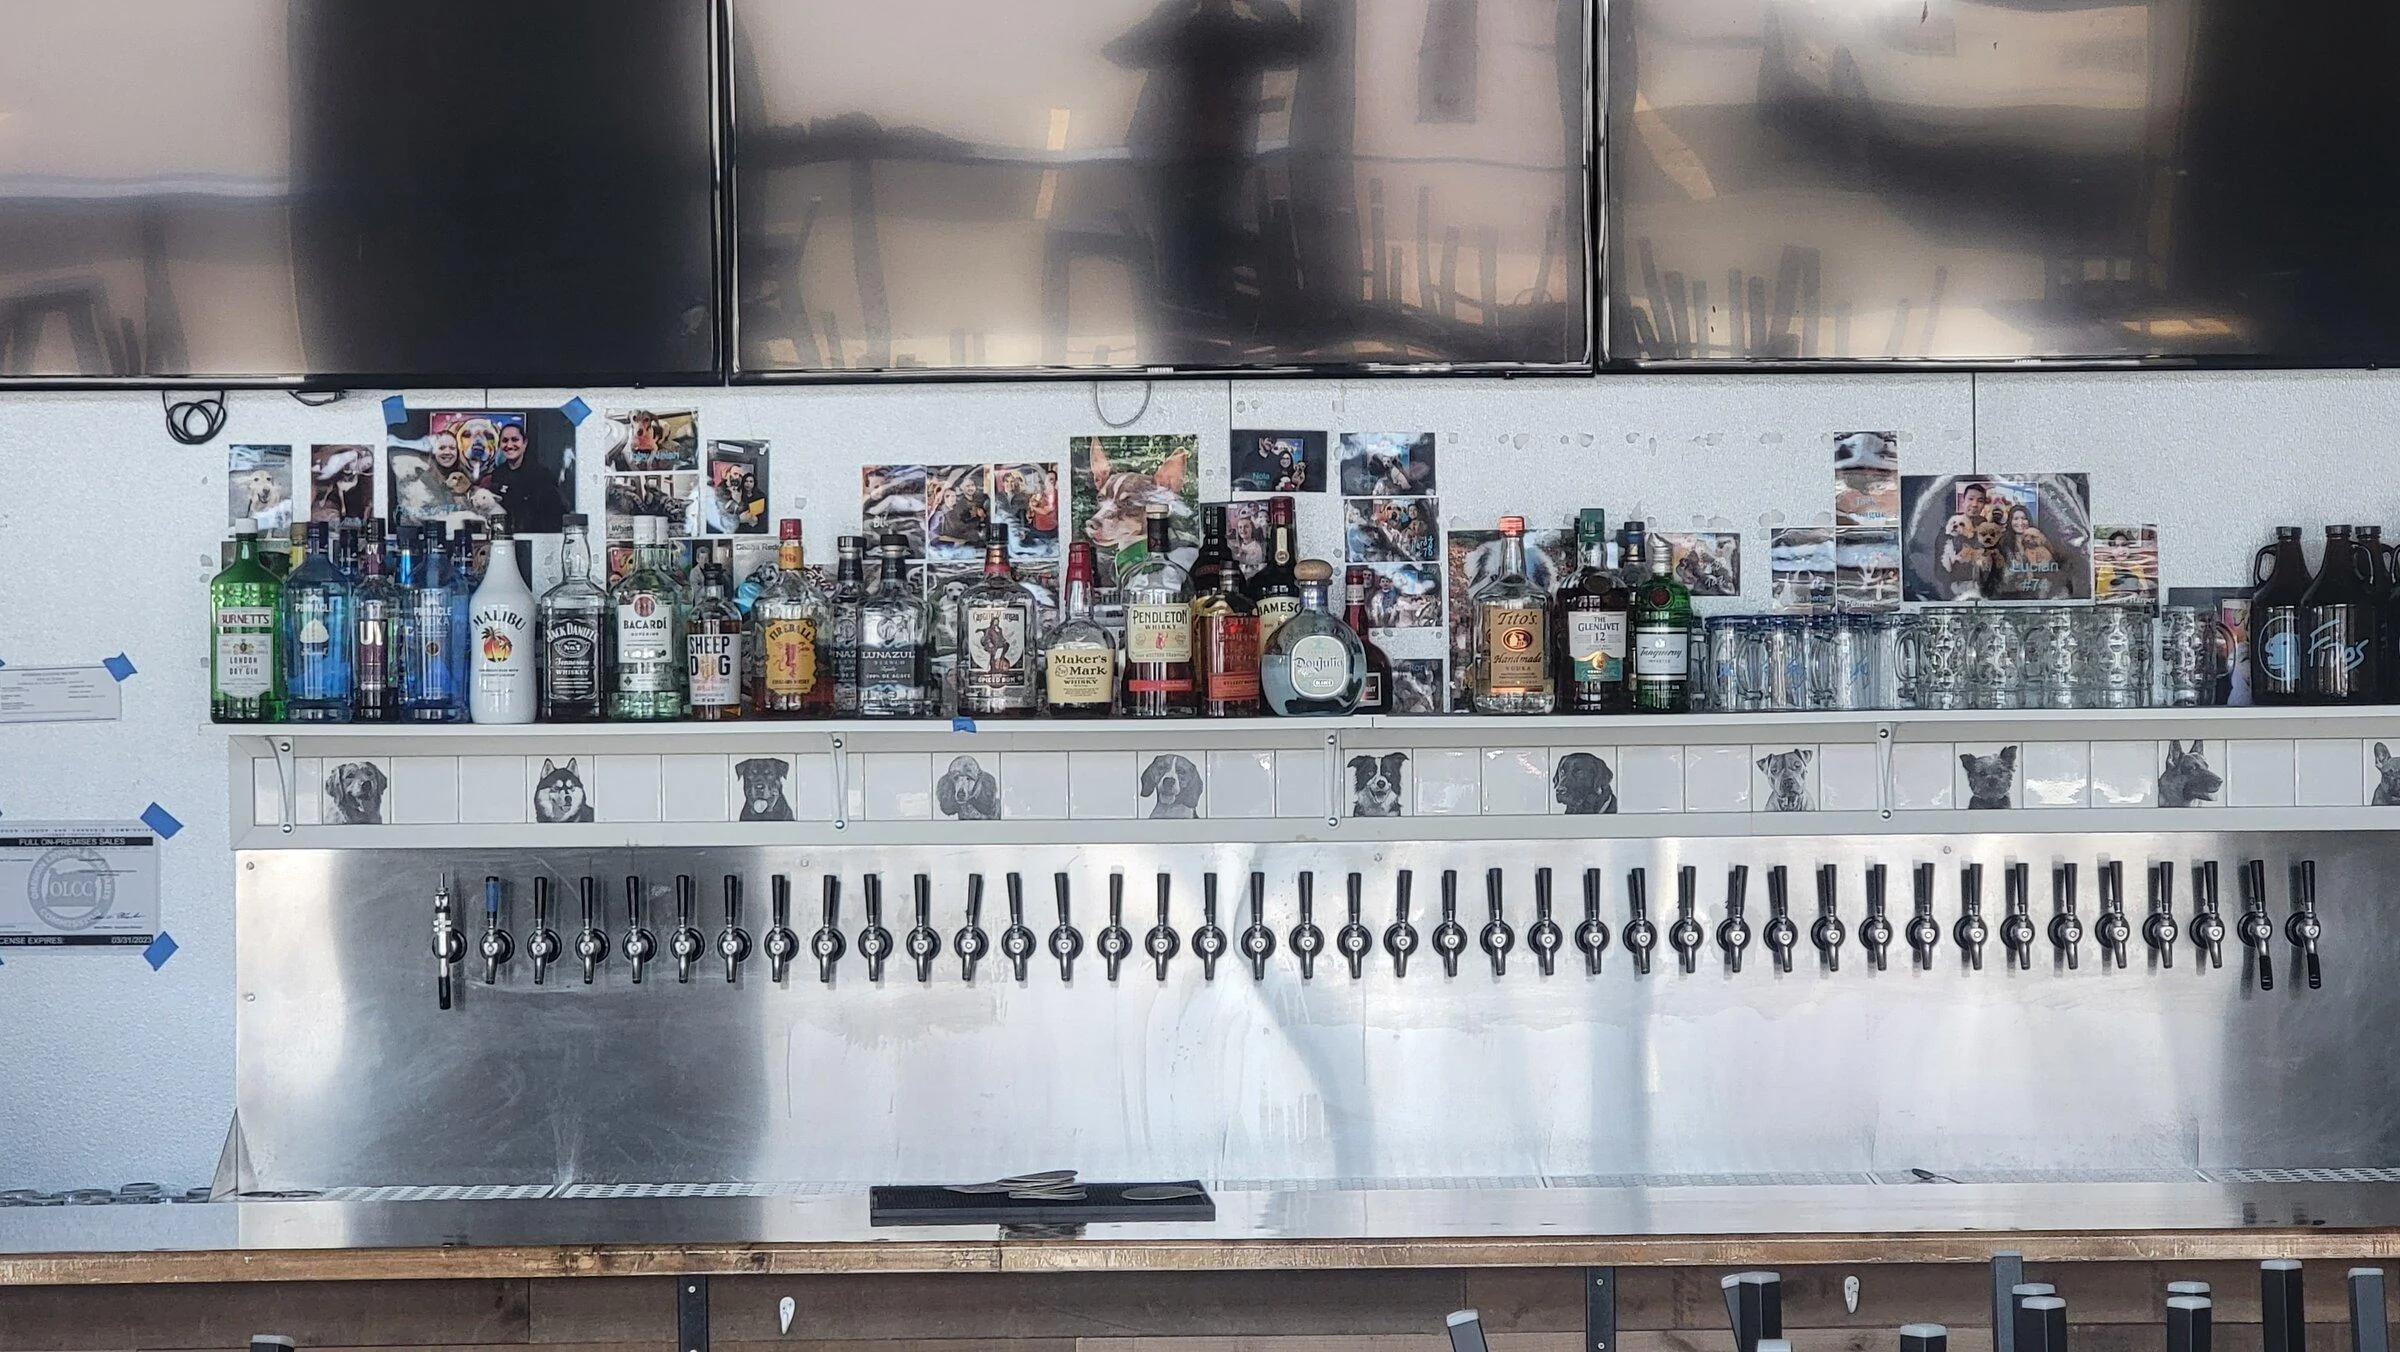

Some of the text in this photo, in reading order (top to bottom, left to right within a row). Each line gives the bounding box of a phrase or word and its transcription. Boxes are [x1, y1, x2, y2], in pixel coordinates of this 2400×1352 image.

[2011, 560, 2059, 573] Lucian
[473, 610, 527, 631] MALIBU
[1132, 609, 1188, 625] PENDLETON
[623, 617, 667, 630] BACARDÍ
[1577, 622, 1620, 632] GLENLIVET
[547, 626, 567, 643] JACK
[1594, 632, 1606, 642] 12
[690, 635, 731, 655] SHEEP
[229, 656, 258, 664] LONDON
[862, 651, 916, 659] LUNAZUL
[1054, 655, 1108, 664] Maker's
[1492, 652, 1543, 664] Handmade
[229, 667, 243, 675] DRY
[690, 655, 731, 676] DG
[1069, 666, 1108, 675] Mark
[18, 837, 127, 846] FULL ON-PREMISES SALES
[51, 880, 96, 898] OLCC
